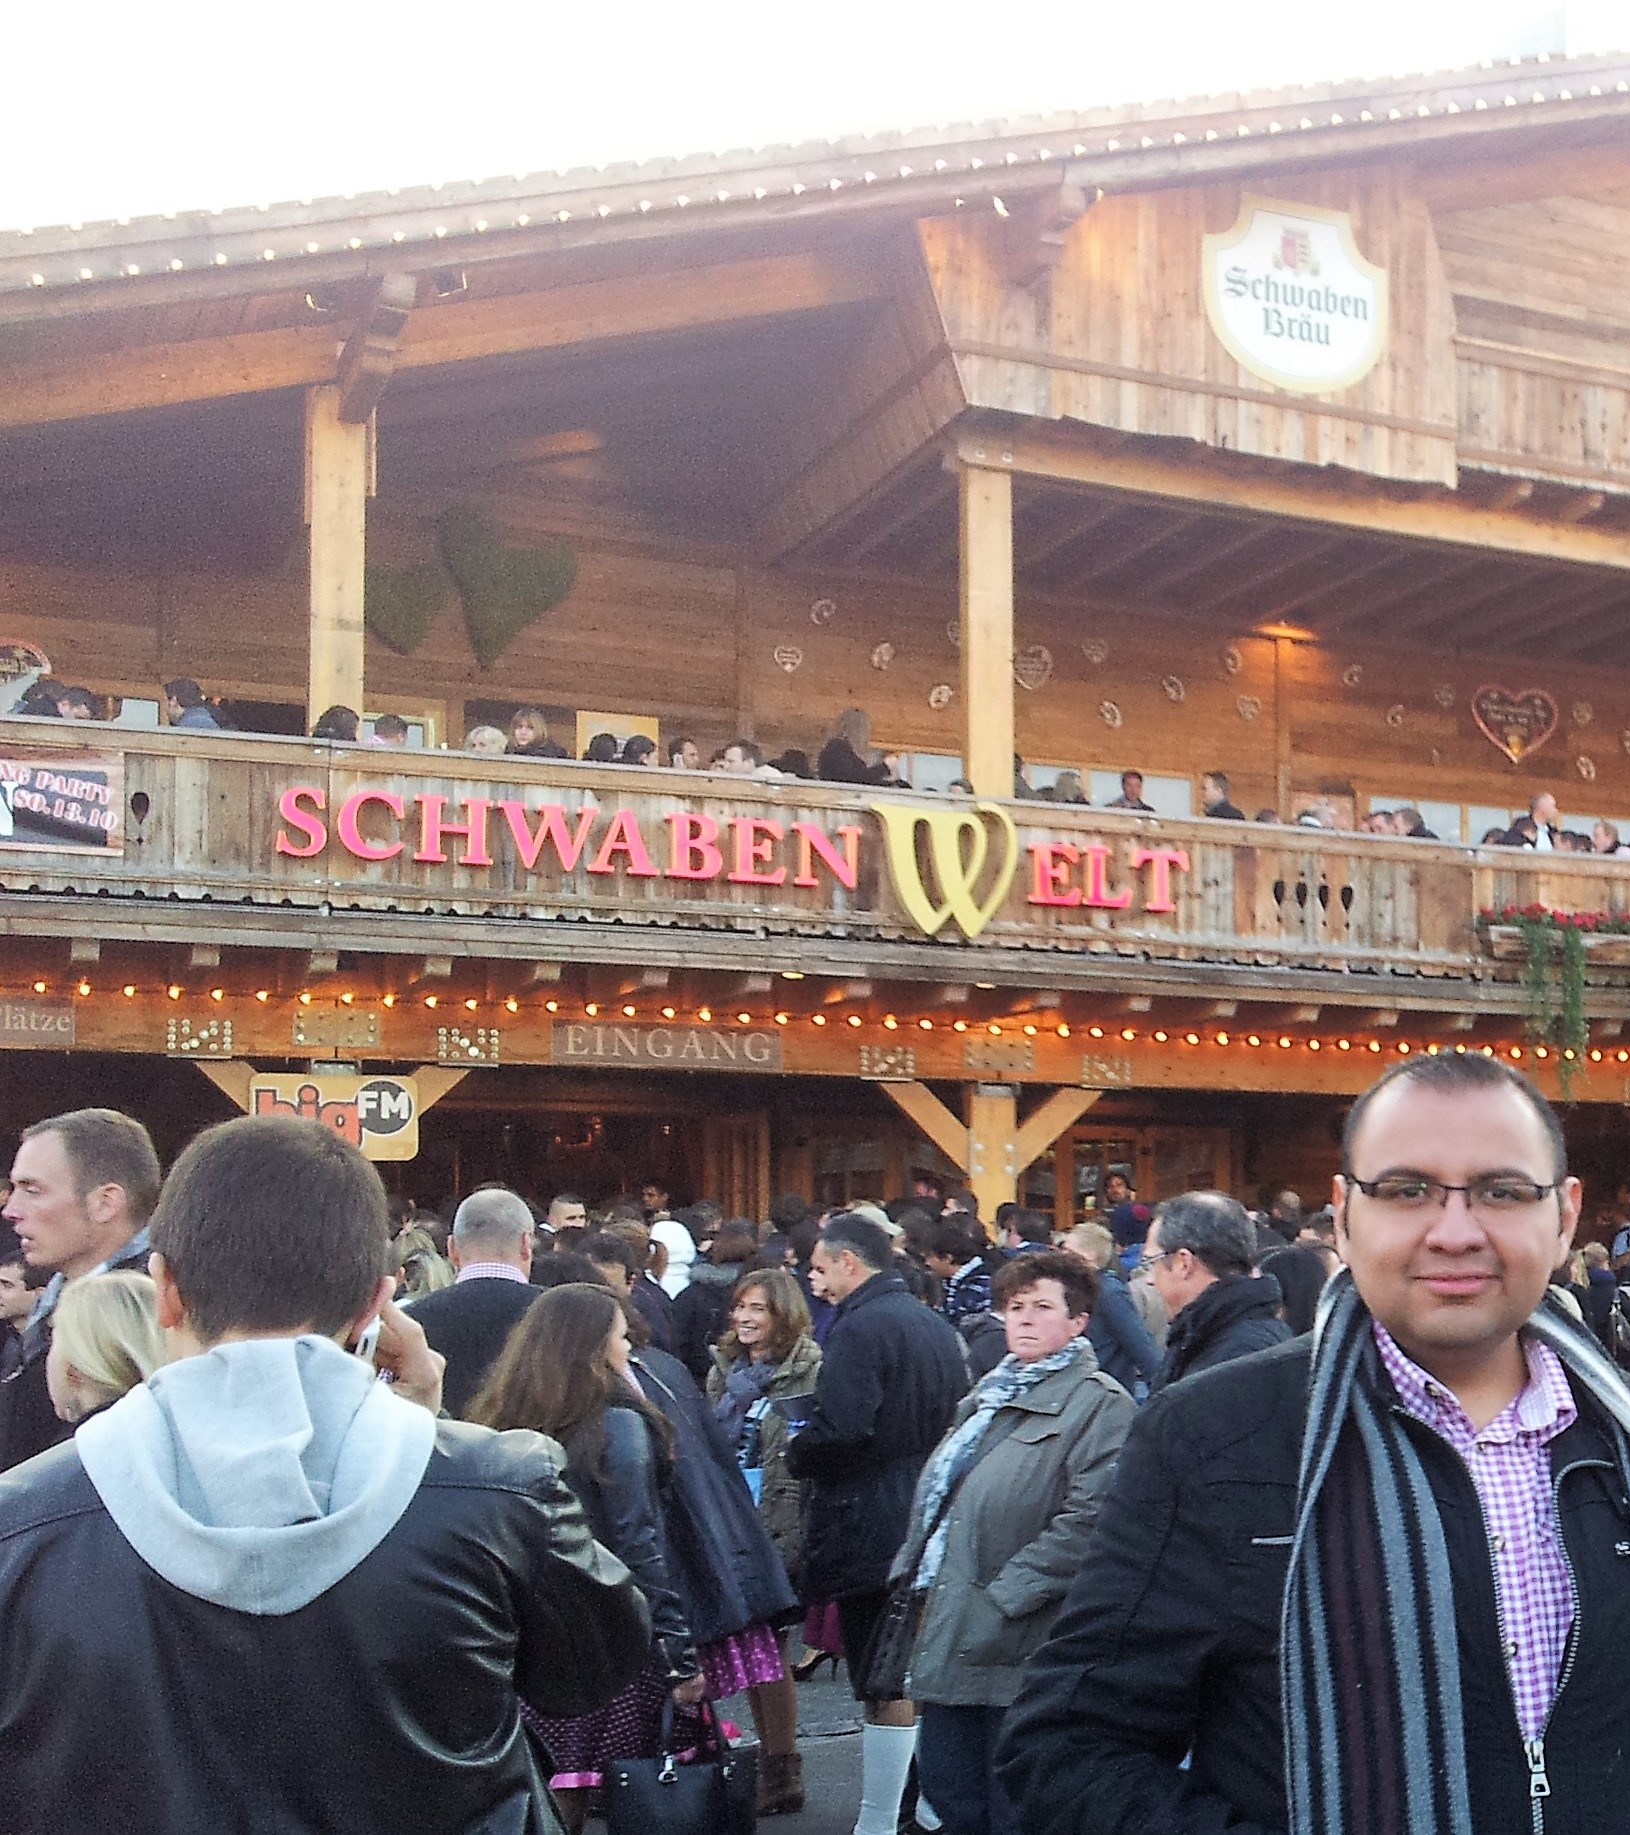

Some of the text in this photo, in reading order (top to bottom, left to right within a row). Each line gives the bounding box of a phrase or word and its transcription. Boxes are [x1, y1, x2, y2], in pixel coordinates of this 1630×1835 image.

[1224, 264, 1369, 321] Schwaben
[1262, 307, 1331, 346] Bräu
[35, 770, 110, 805] PARTY
[14, 789, 118, 831] SO.13.10
[276, 786, 1190, 938] SCHWABEN WELT
[0, 1004, 70, 1032] lätze
[564, 1024, 770, 1063] EINGANG
